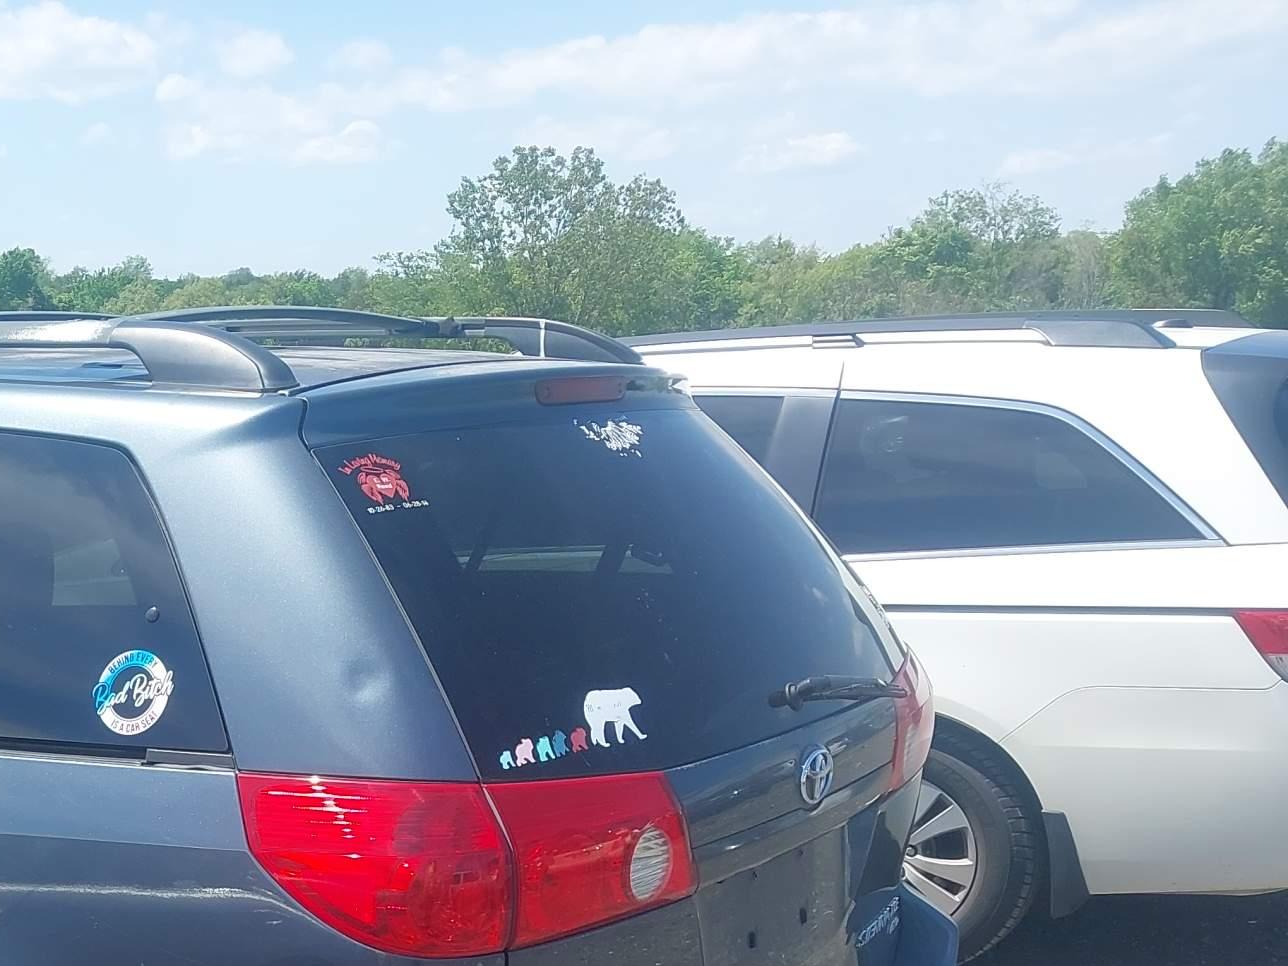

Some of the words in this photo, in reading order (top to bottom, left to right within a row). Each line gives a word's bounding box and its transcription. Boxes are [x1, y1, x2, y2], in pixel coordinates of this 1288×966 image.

[108, 652, 134, 673] BEHIND
[136, 651, 158, 668] EVERY
[92, 681, 131, 715] Bad
[130, 670, 174, 707] Bitch
